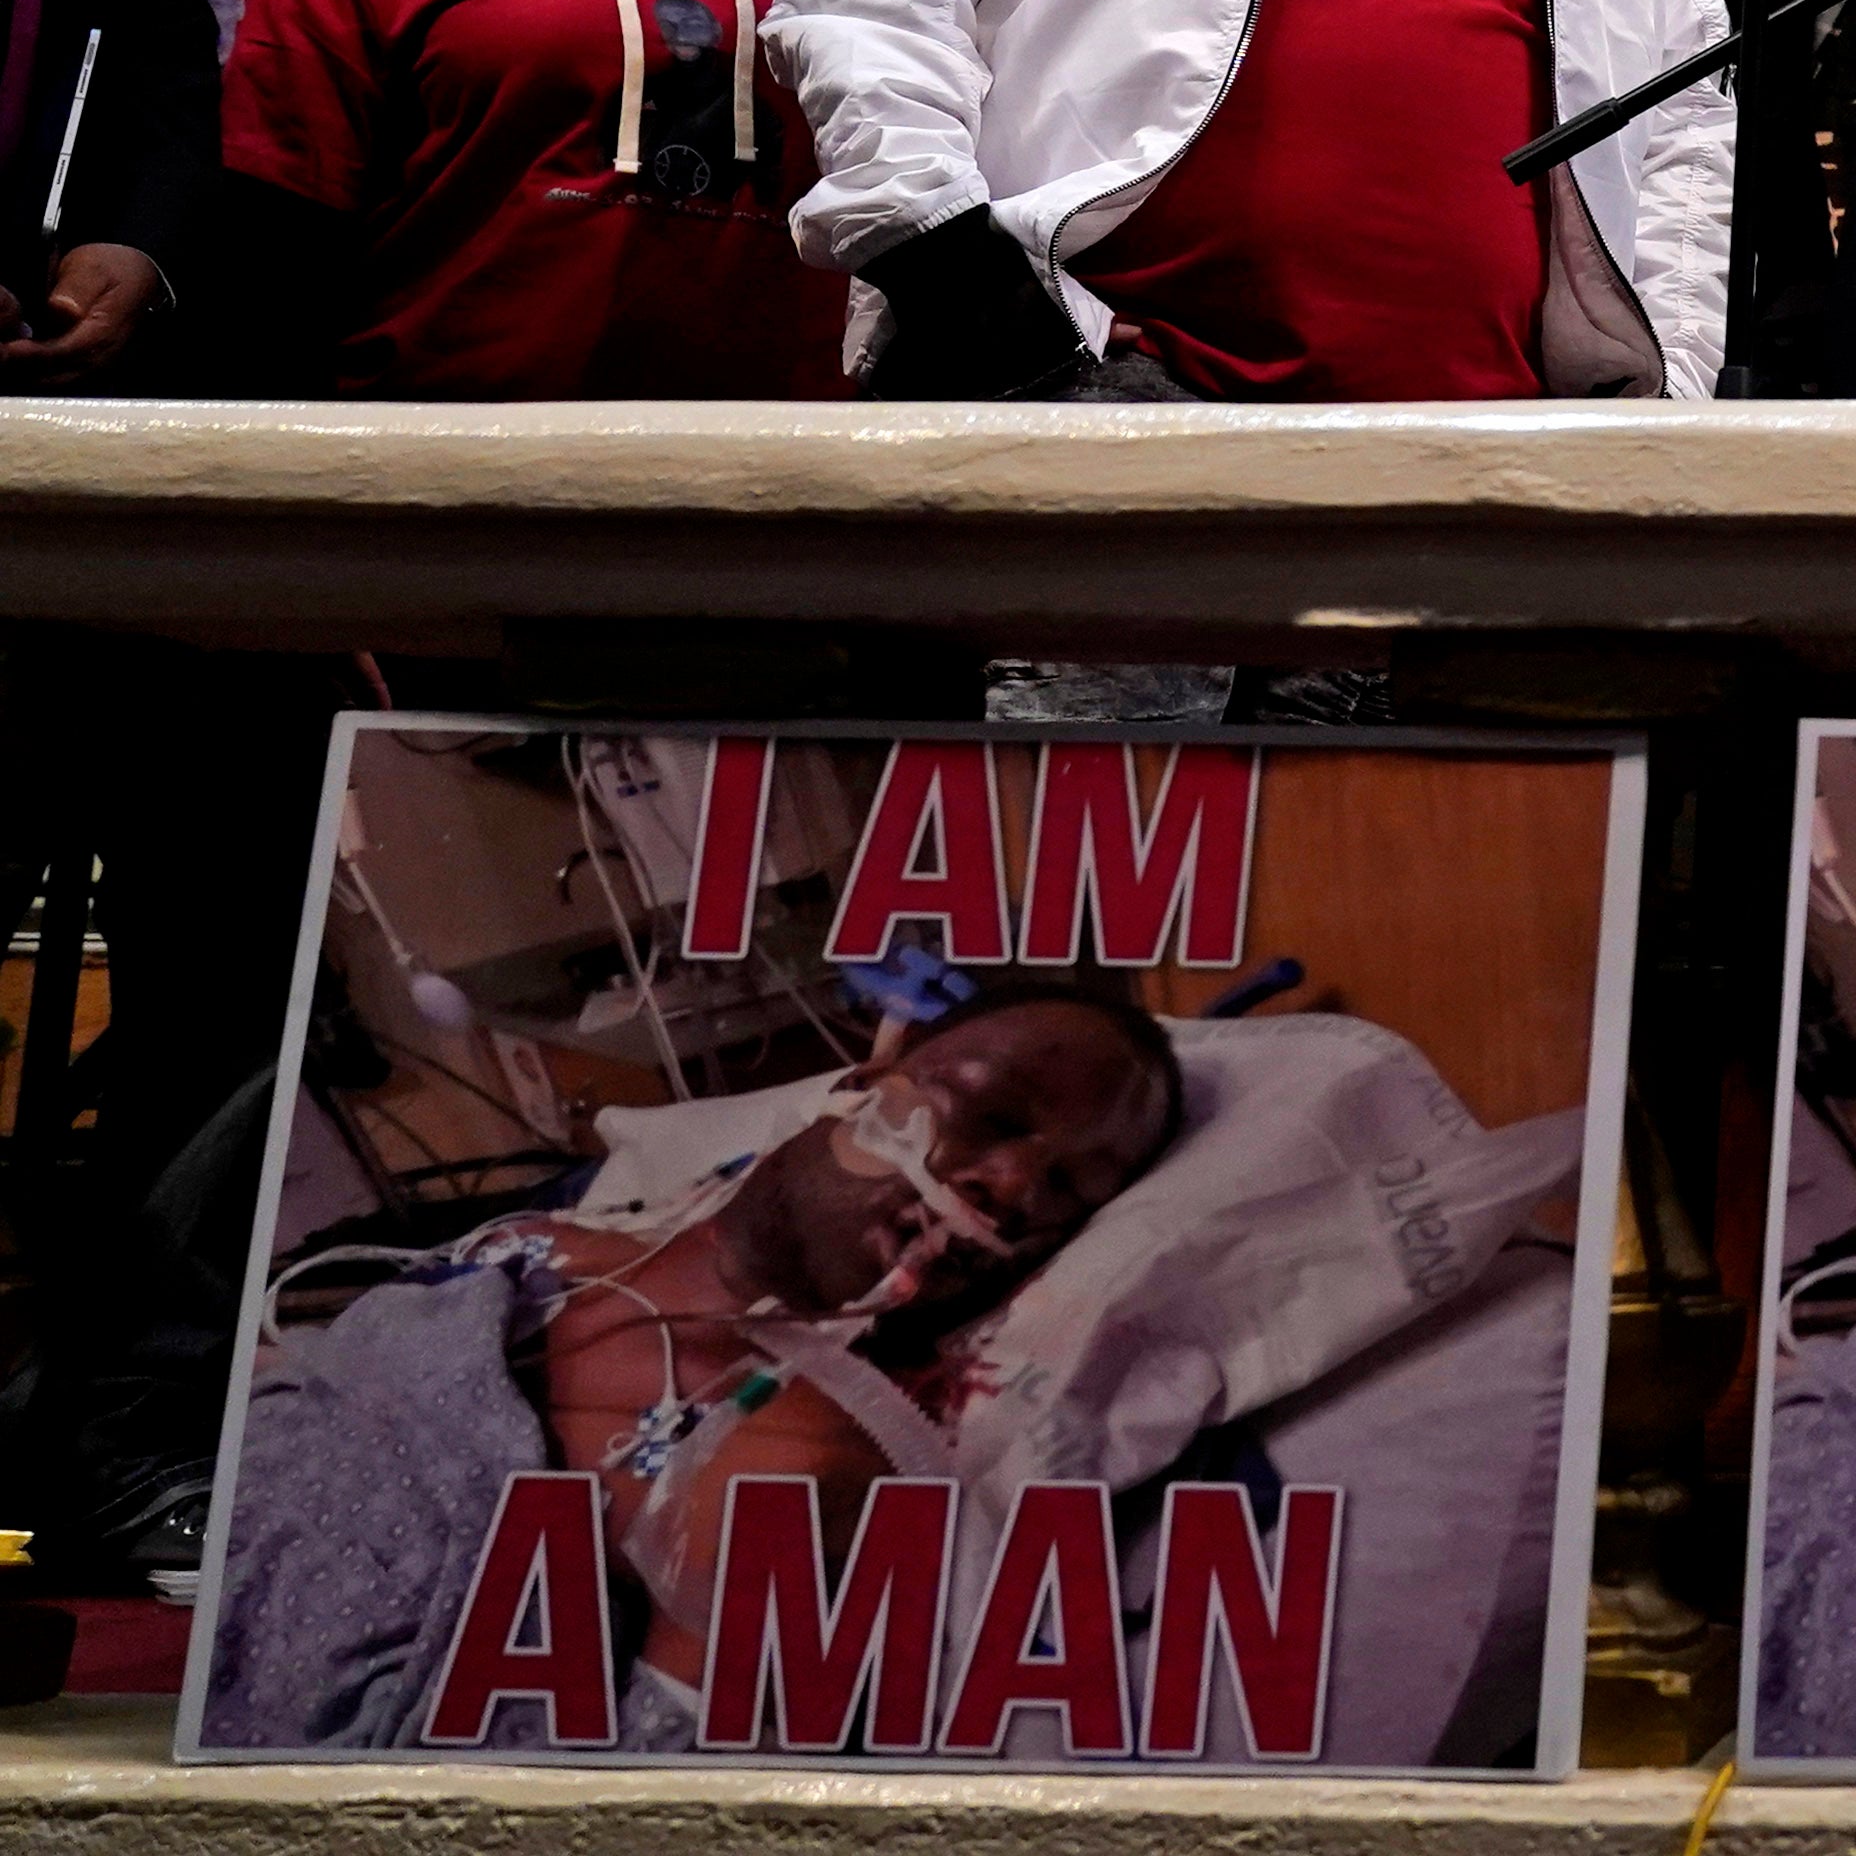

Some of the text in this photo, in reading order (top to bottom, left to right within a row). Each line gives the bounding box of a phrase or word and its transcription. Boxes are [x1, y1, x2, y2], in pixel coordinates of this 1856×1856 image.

[681, 735, 1261, 970] I AM
[418, 1469, 1346, 1760] A MAN
